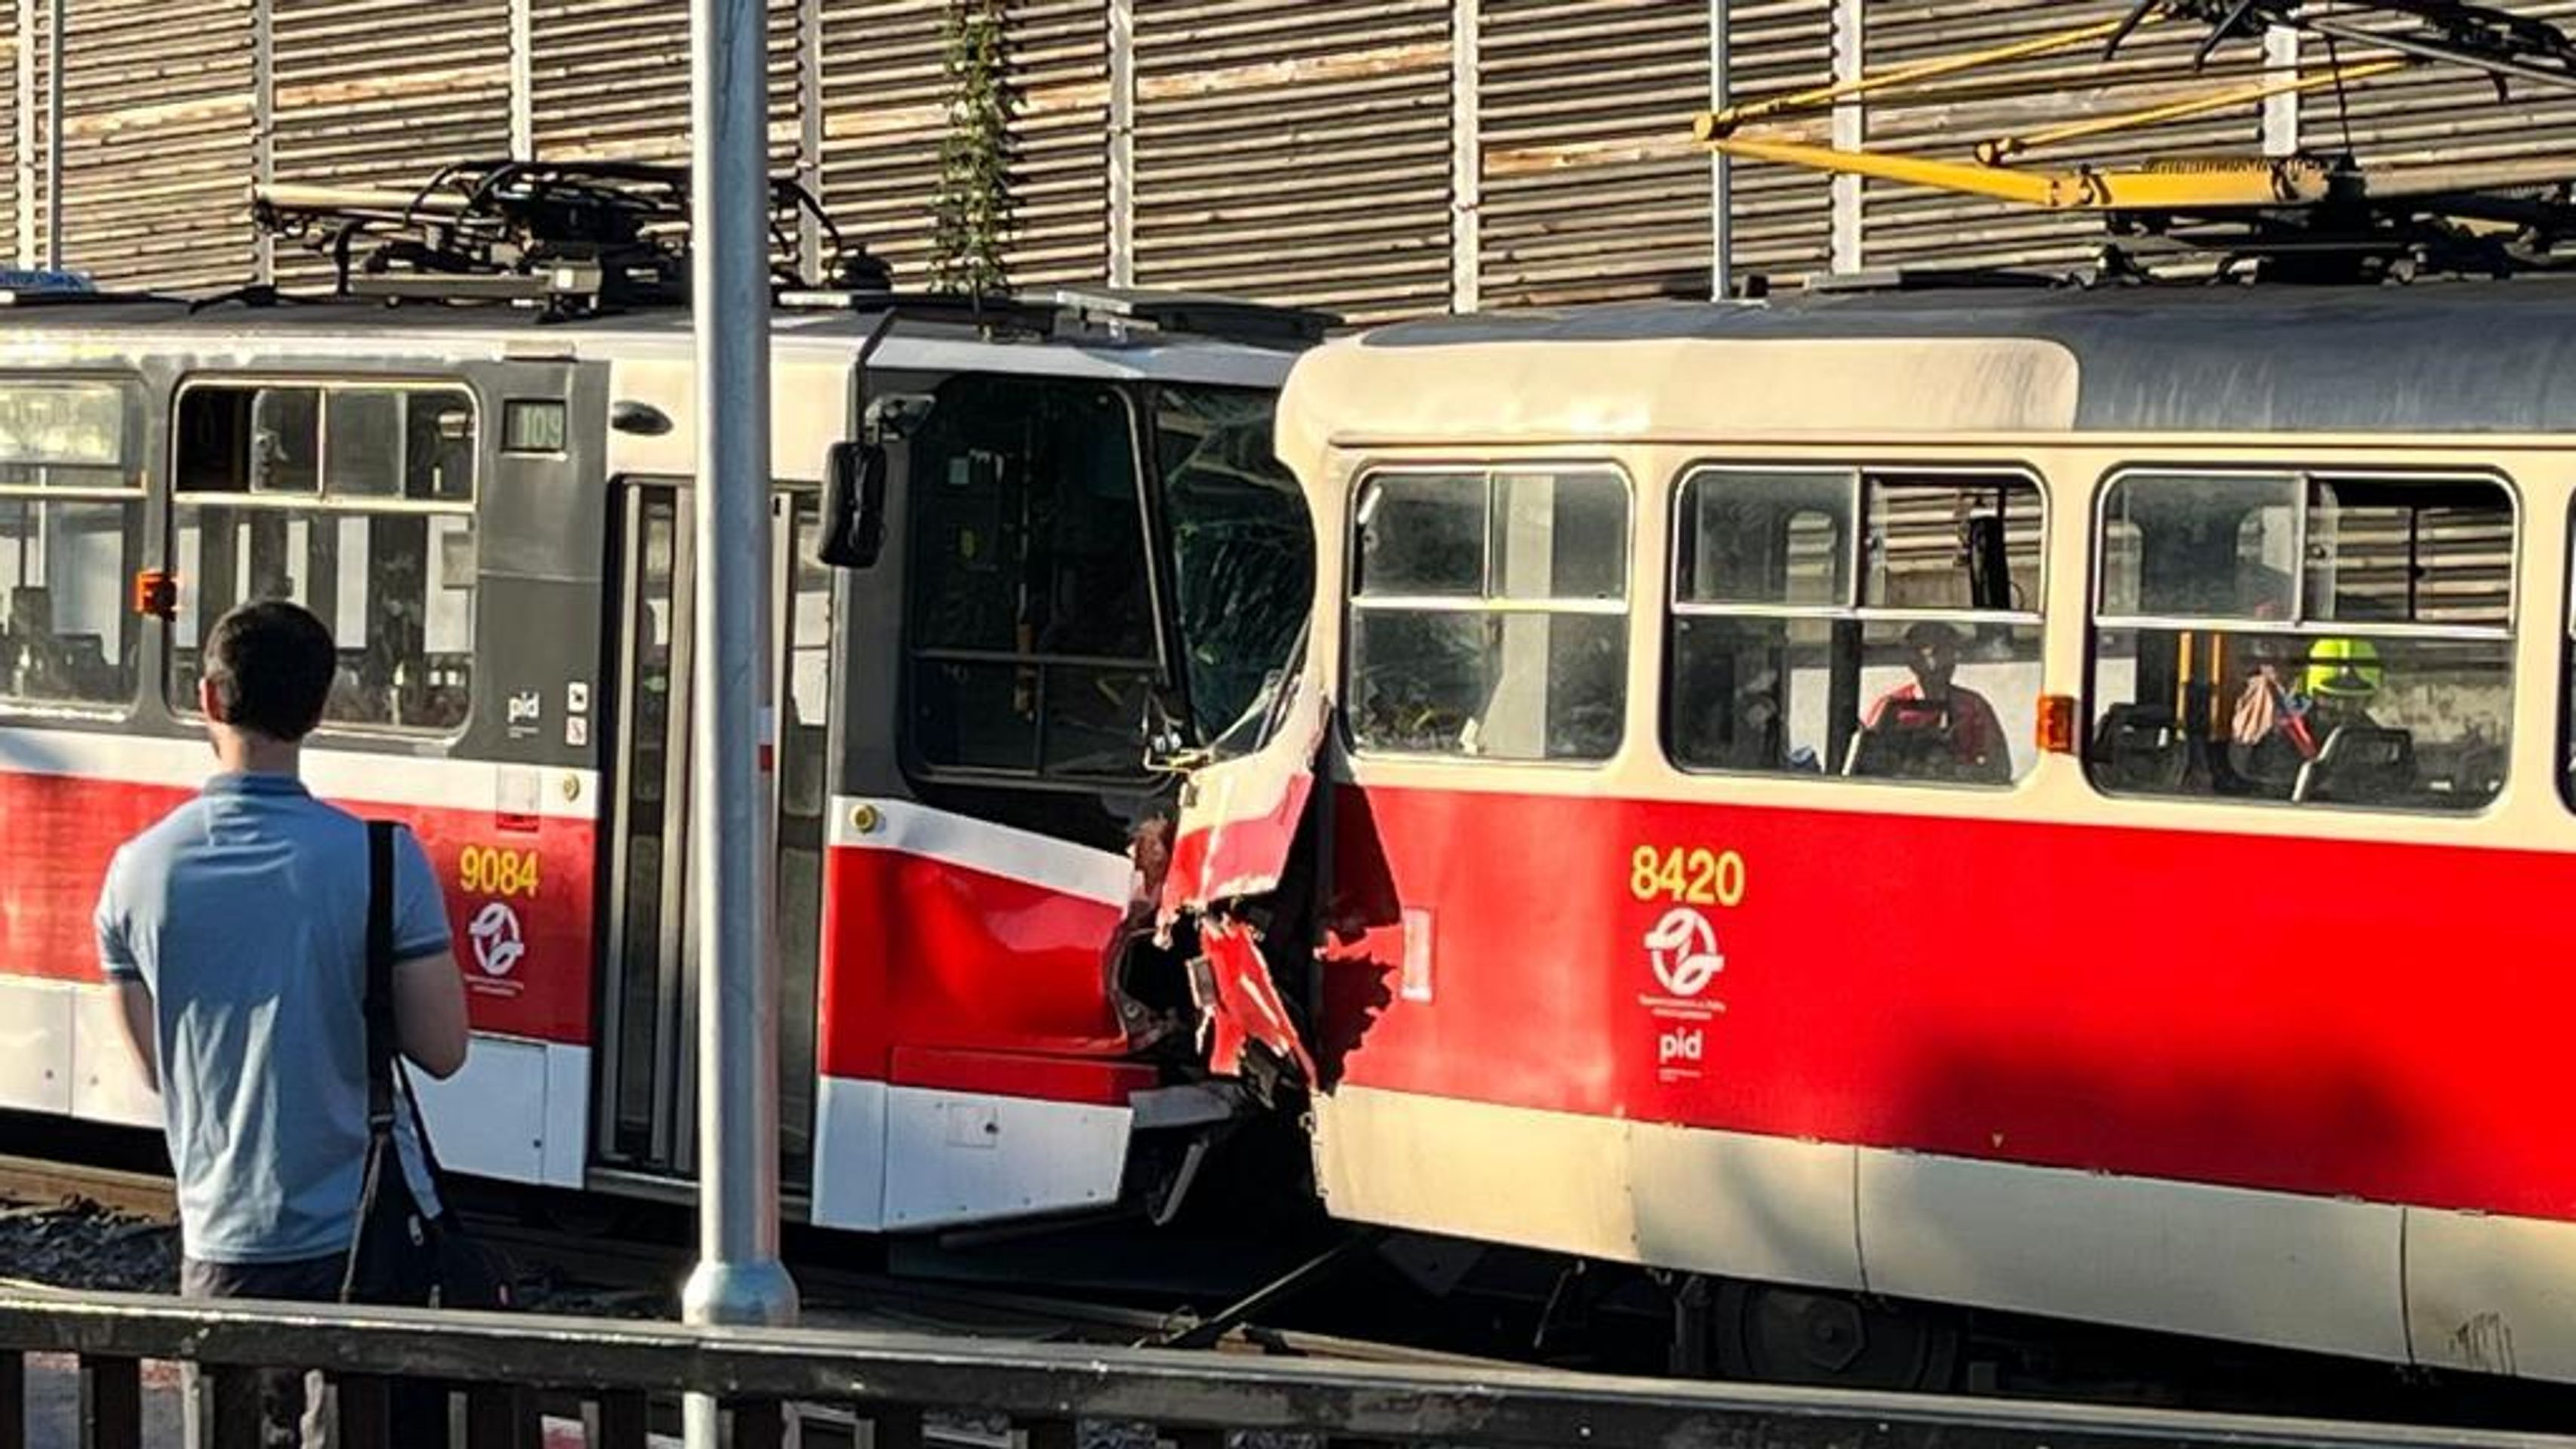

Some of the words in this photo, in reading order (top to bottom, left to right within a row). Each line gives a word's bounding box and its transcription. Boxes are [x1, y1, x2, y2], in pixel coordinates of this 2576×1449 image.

[508, 692, 540, 723] pid
[460, 845, 539, 897] 9084
[1630, 844, 1745, 906] 8420
[1660, 1027, 1703, 1064] pid
